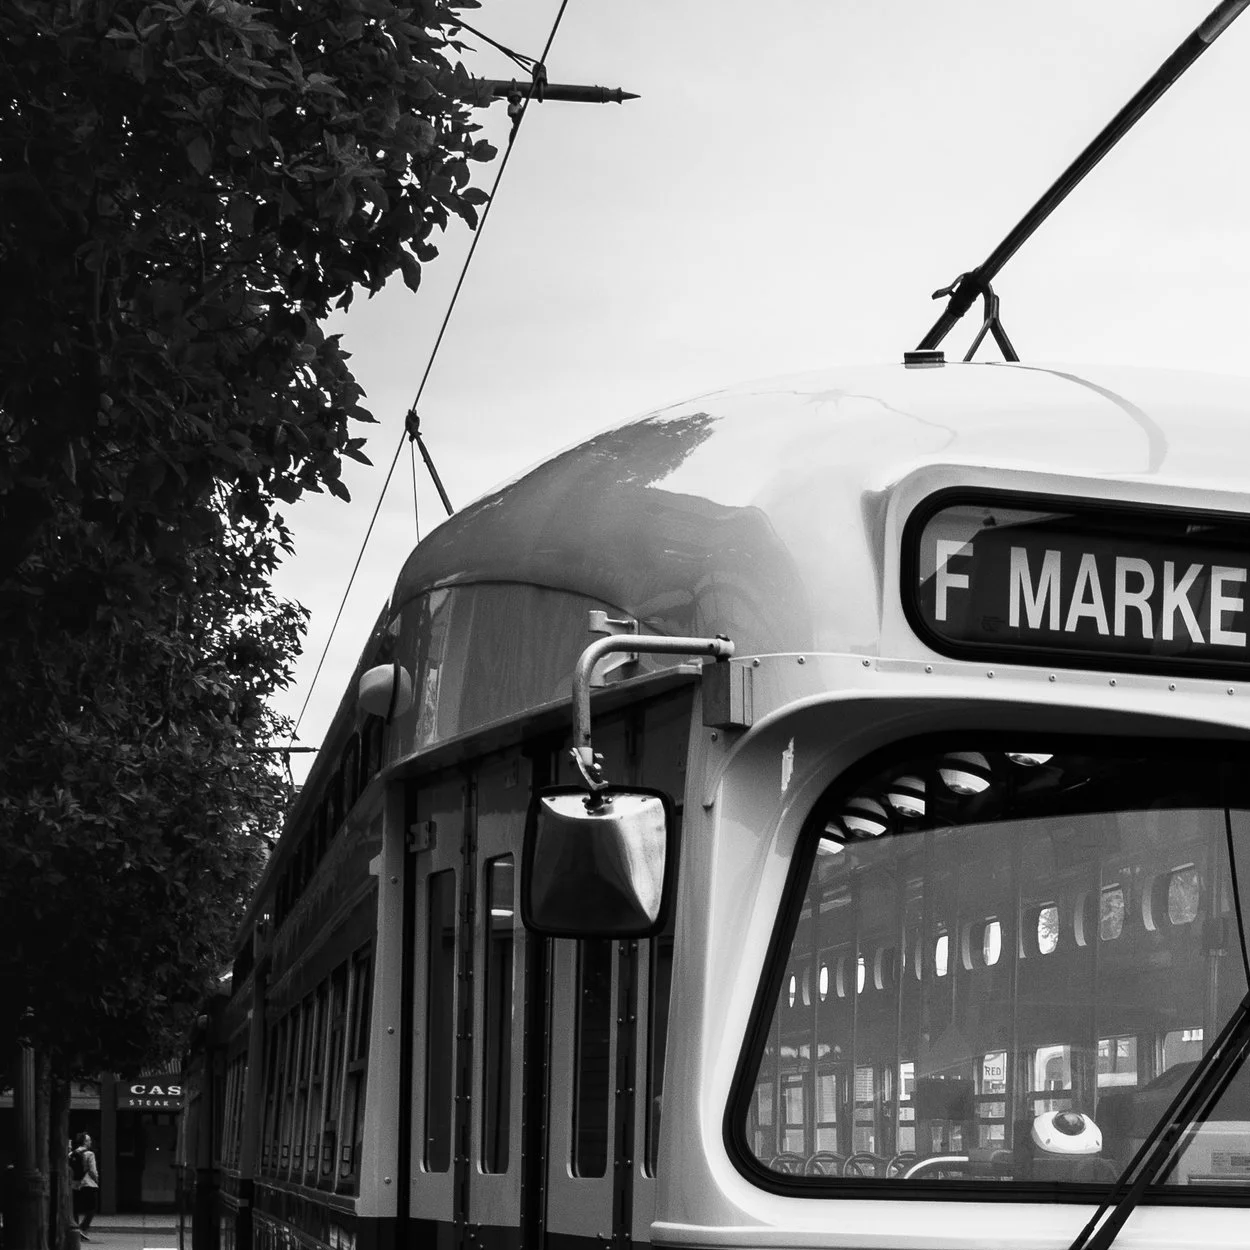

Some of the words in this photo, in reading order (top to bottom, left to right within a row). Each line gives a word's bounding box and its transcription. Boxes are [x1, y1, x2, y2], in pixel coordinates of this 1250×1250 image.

[935, 540, 974, 621] F
[130, 1084, 182, 1096] CAS
[129, 1099, 169, 1107] STEAK
